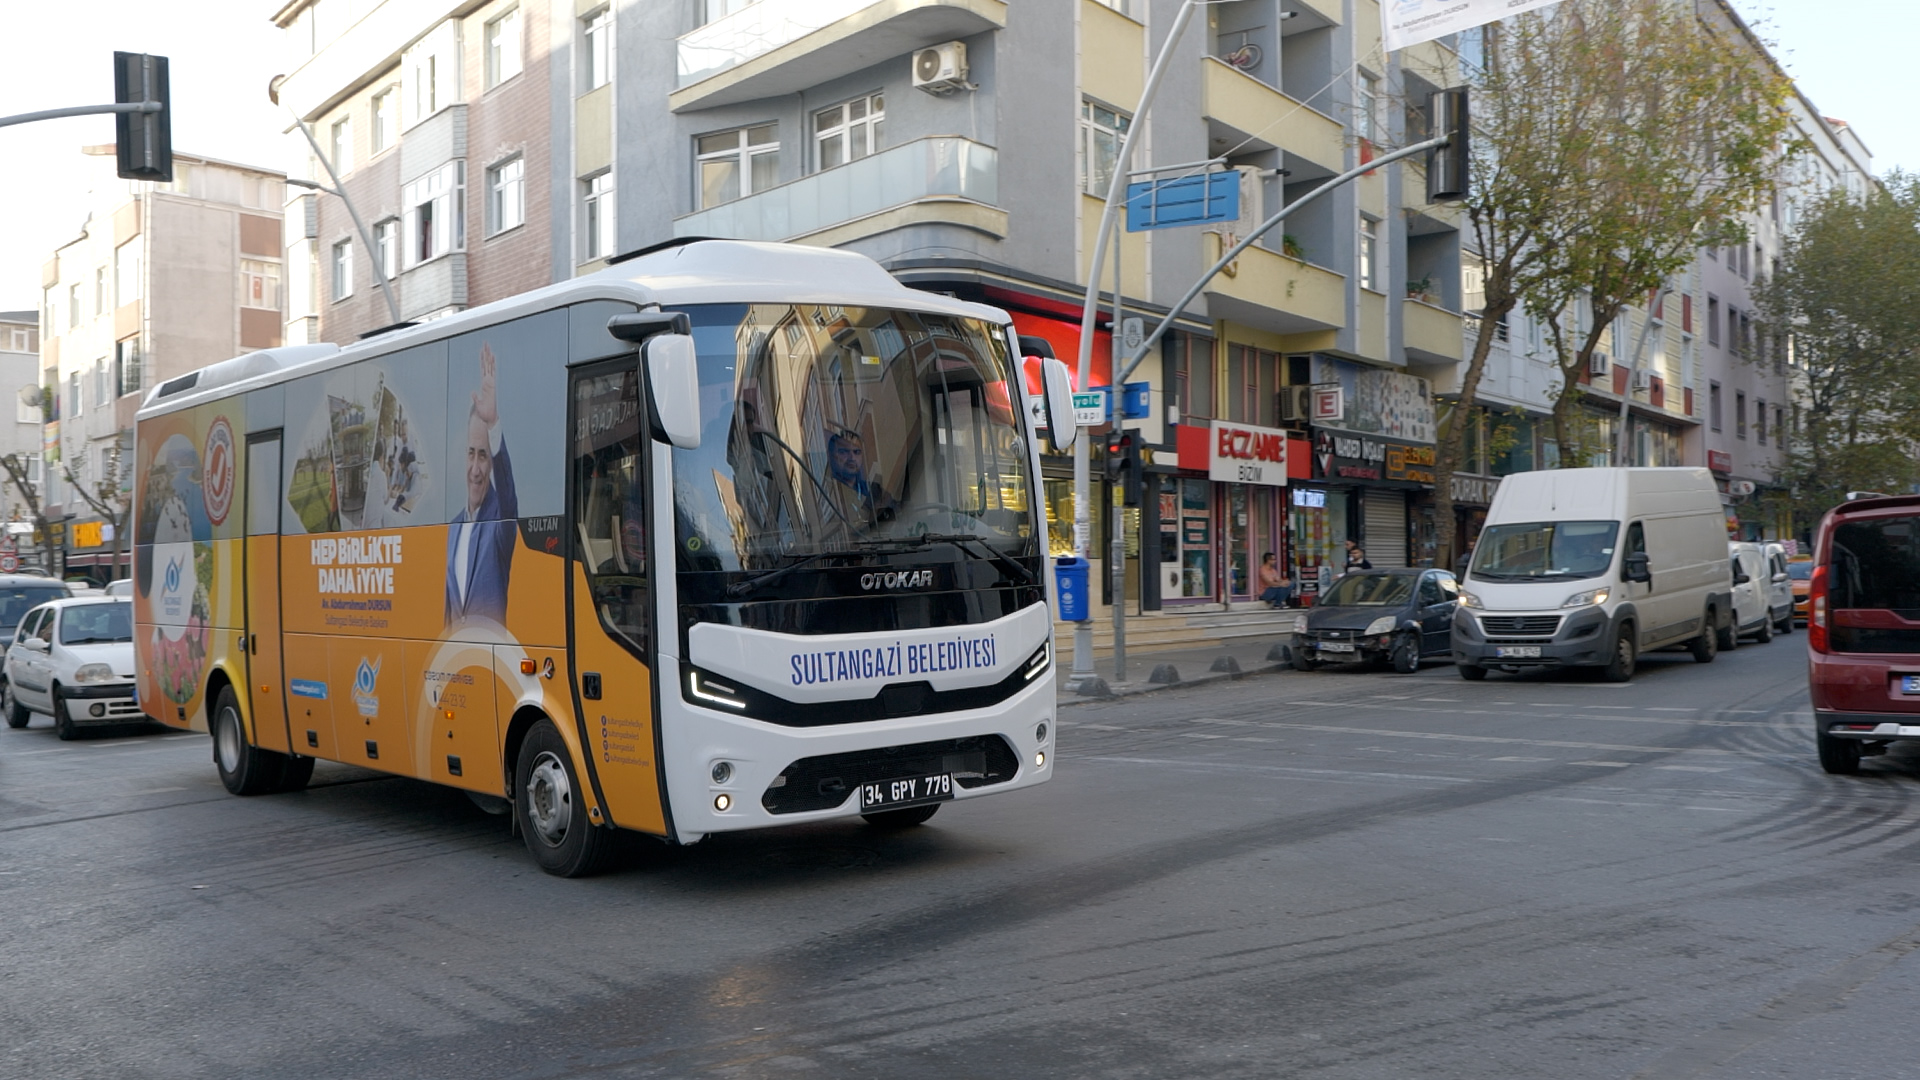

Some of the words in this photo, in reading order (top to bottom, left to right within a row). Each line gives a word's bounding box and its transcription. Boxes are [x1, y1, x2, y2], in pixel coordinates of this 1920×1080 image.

[1320, 394, 1334, 414] E
[1217, 427, 1285, 463] ECZANE
[1238, 462, 1263, 482] BİZİM
[528, 517, 559, 533] SULTAN
[311, 538, 337, 565] HEP
[337, 534, 403, 564] BİRLİKTE
[318, 568, 356, 593] DAHA
[860, 570, 933, 590] OTOKAR
[790, 641, 901, 686] SULTANGAZİ
[907, 633, 996, 674] BELEDİYESİ
[865, 784, 883, 804] 34
[891, 779, 916, 801] GPY
[925, 774, 950, 796] 778
